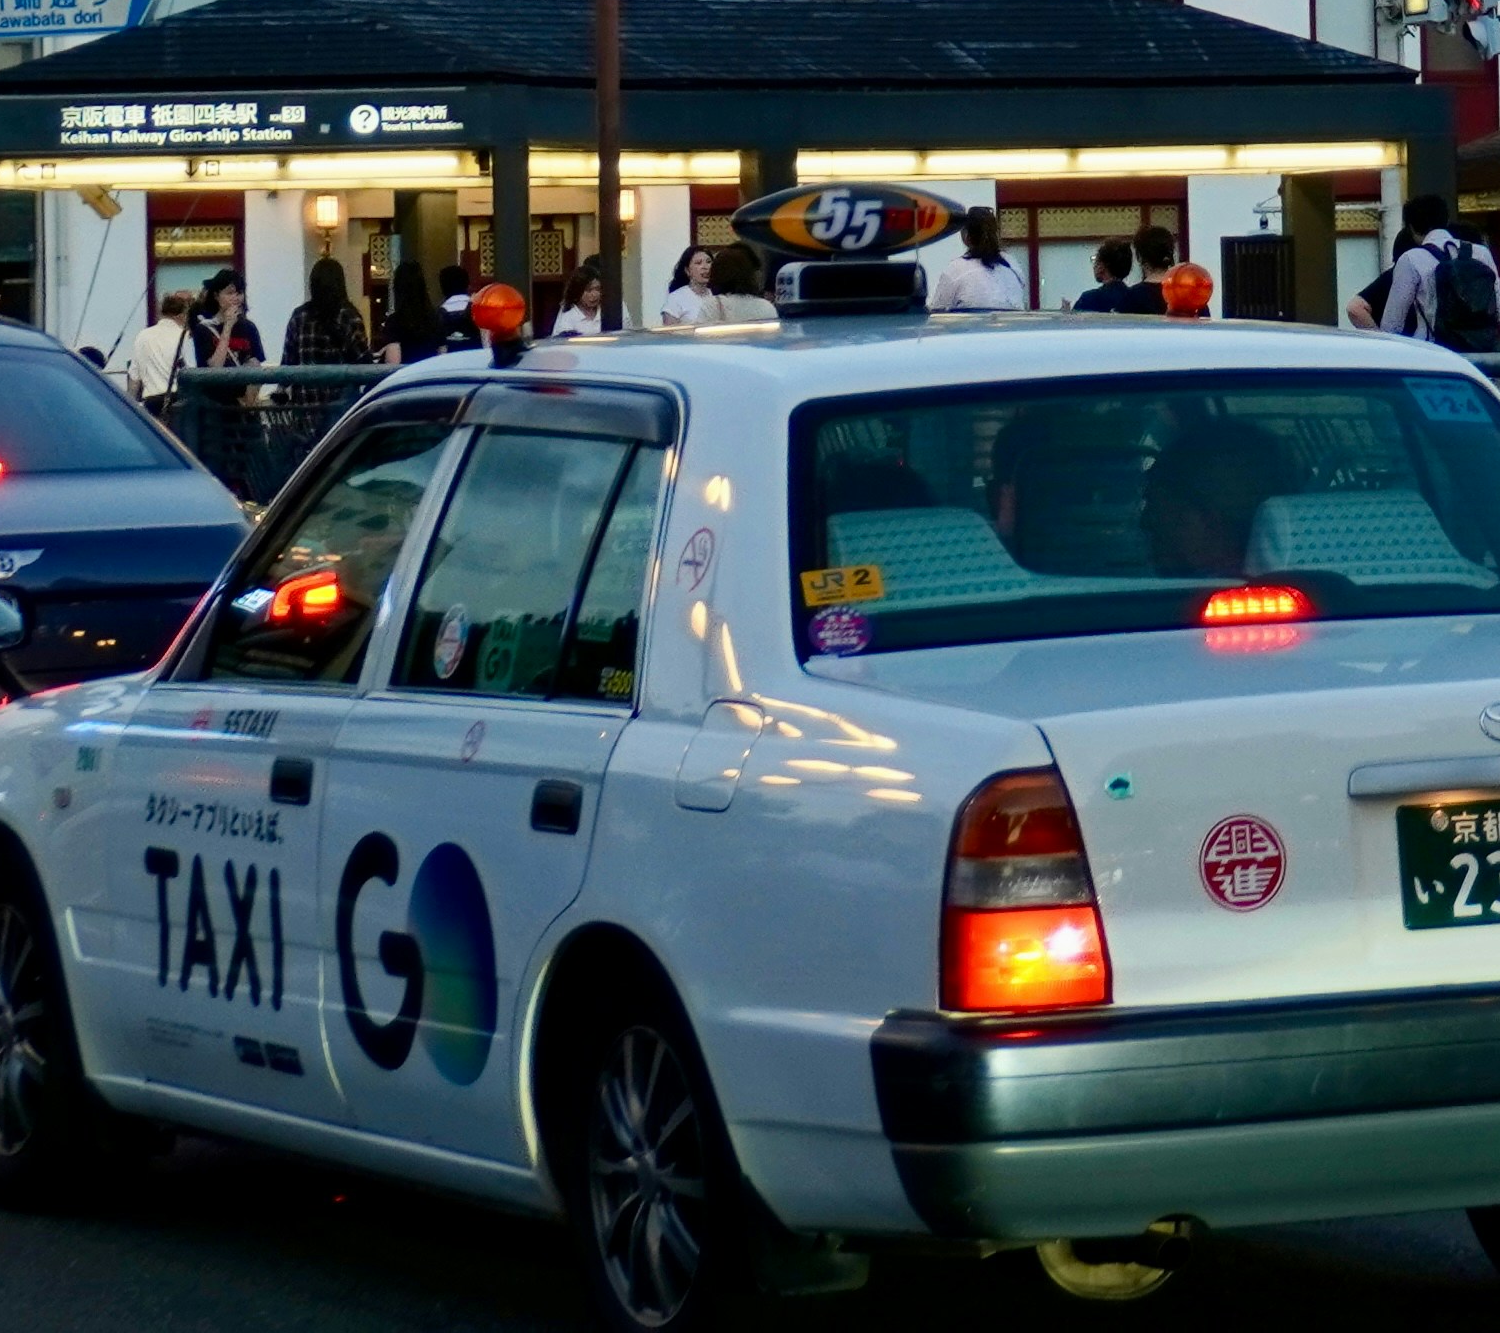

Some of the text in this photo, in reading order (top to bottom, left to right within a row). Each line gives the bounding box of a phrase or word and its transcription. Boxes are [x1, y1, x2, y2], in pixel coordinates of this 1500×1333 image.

[73, 8, 103, 25] dori
[60, 105, 146, 128] 京阪電車
[60, 130, 108, 145] Keihan
[111, 129, 166, 146] Railway
[242, 126, 292, 141] Station
[811, 189, 884, 250] 55
[810, 568, 872, 589] JR 2
[1413, 875, 1446, 905] い
[144, 830, 498, 1087] TAXI GO
